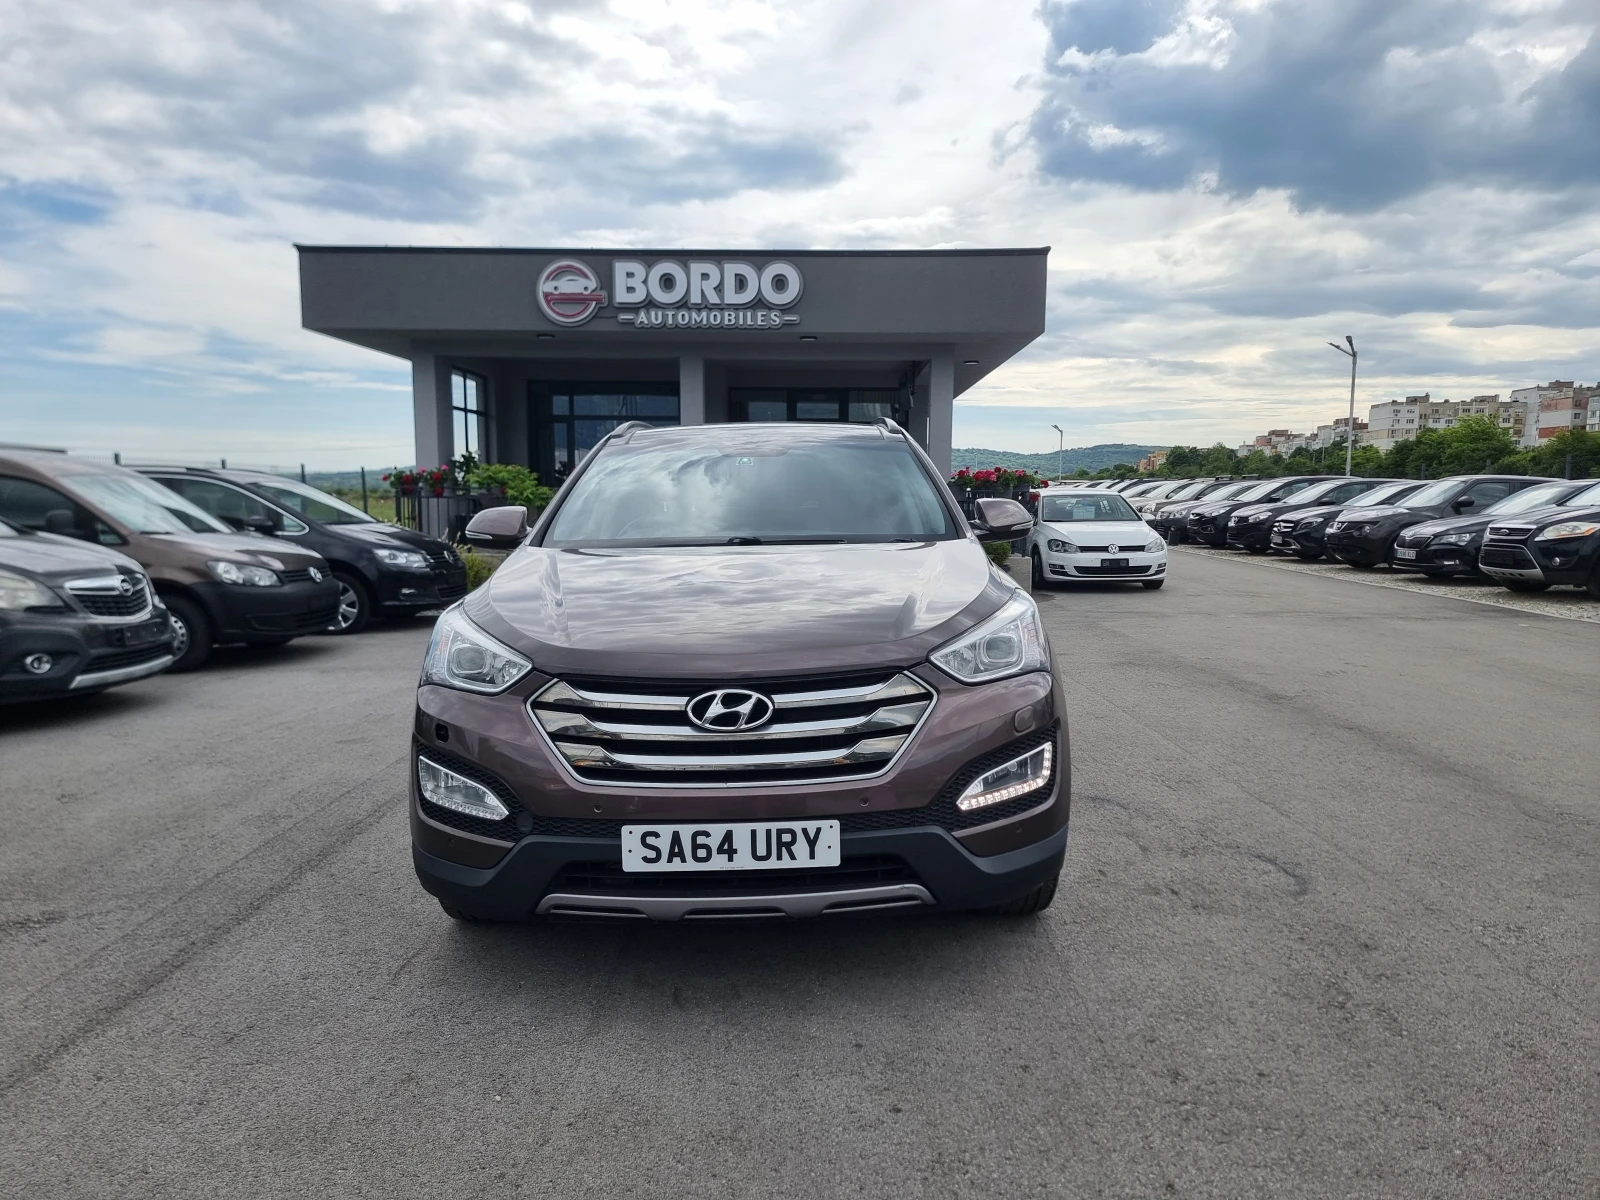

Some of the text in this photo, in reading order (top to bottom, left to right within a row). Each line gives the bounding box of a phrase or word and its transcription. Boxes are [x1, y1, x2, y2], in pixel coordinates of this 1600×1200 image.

[615, 262, 800, 304] BORDO
[637, 310, 781, 326] AUTOMOBILES
[640, 826, 822, 864] SA64 URY
